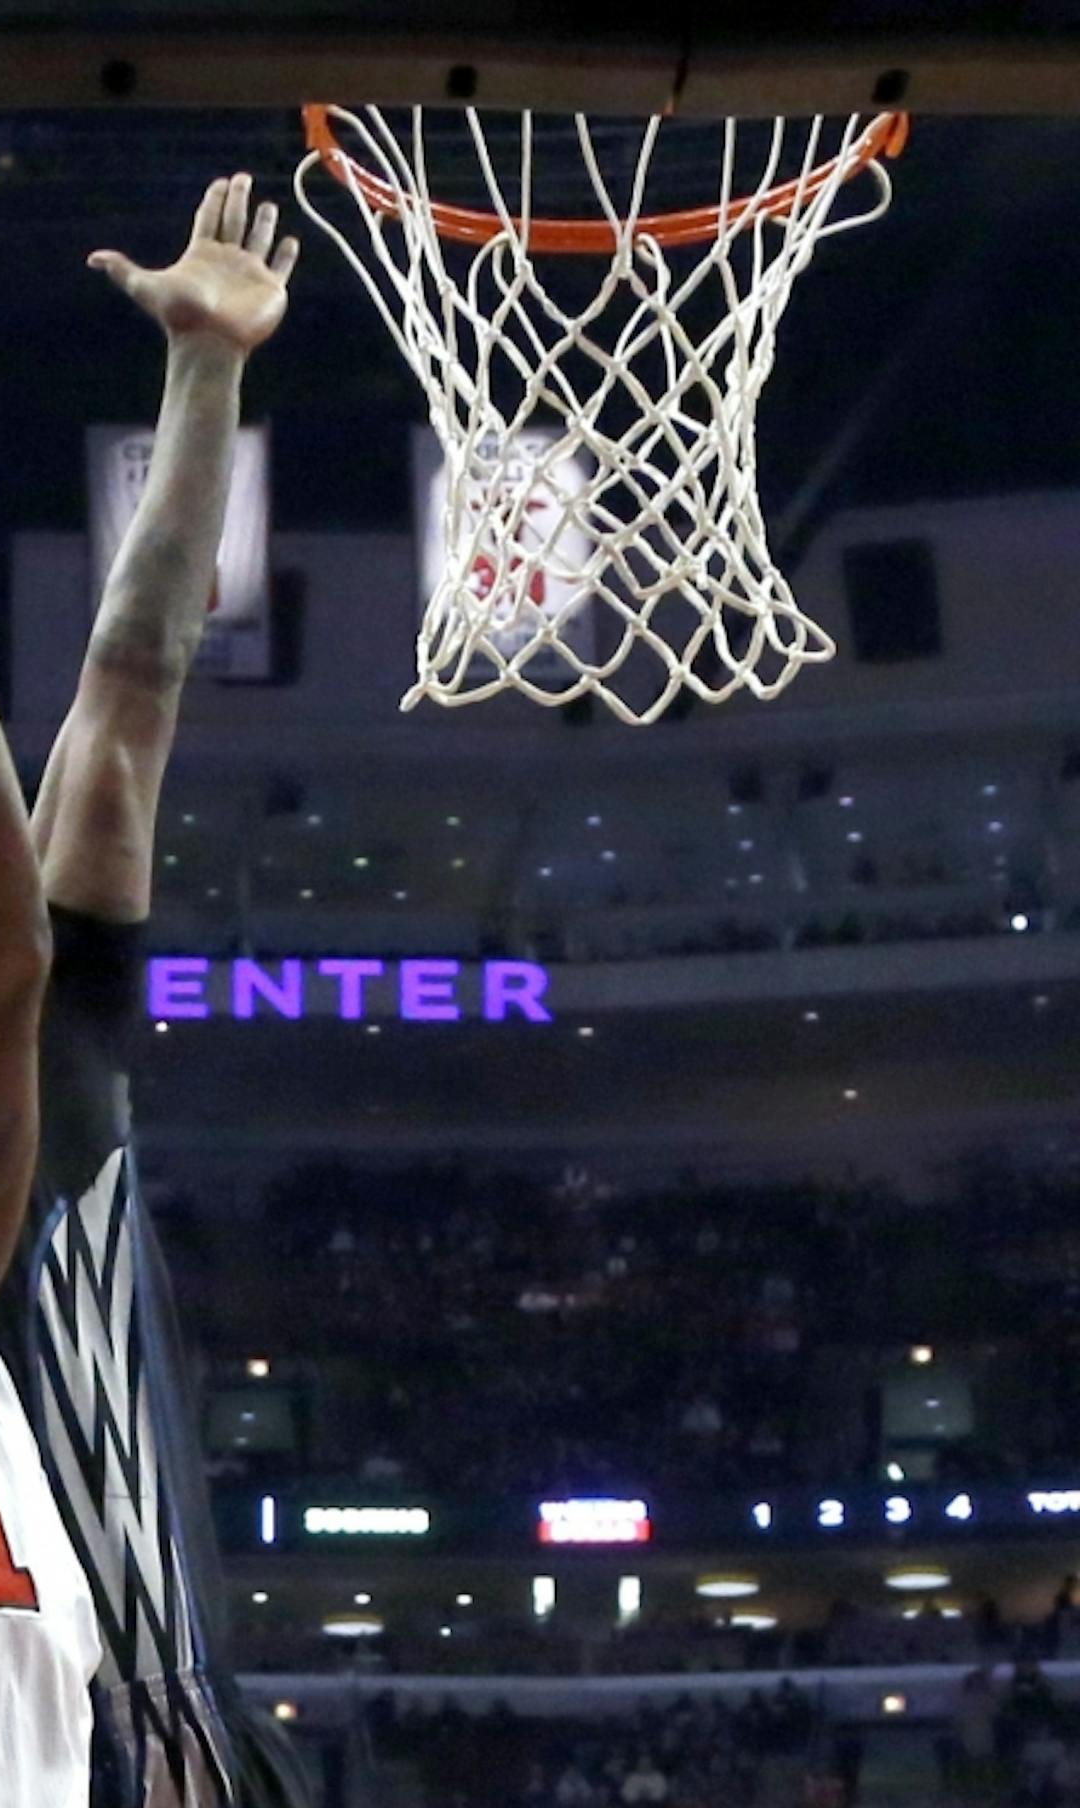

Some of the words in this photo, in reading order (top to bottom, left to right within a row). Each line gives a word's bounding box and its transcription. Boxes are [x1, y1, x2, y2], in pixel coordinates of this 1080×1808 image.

[149, 957, 552, 1021] ENTER
[753, 1502, 770, 1528] 1
[818, 1499, 844, 1526] 2
[885, 1496, 911, 1523] 3
[945, 1493, 971, 1520] 4
